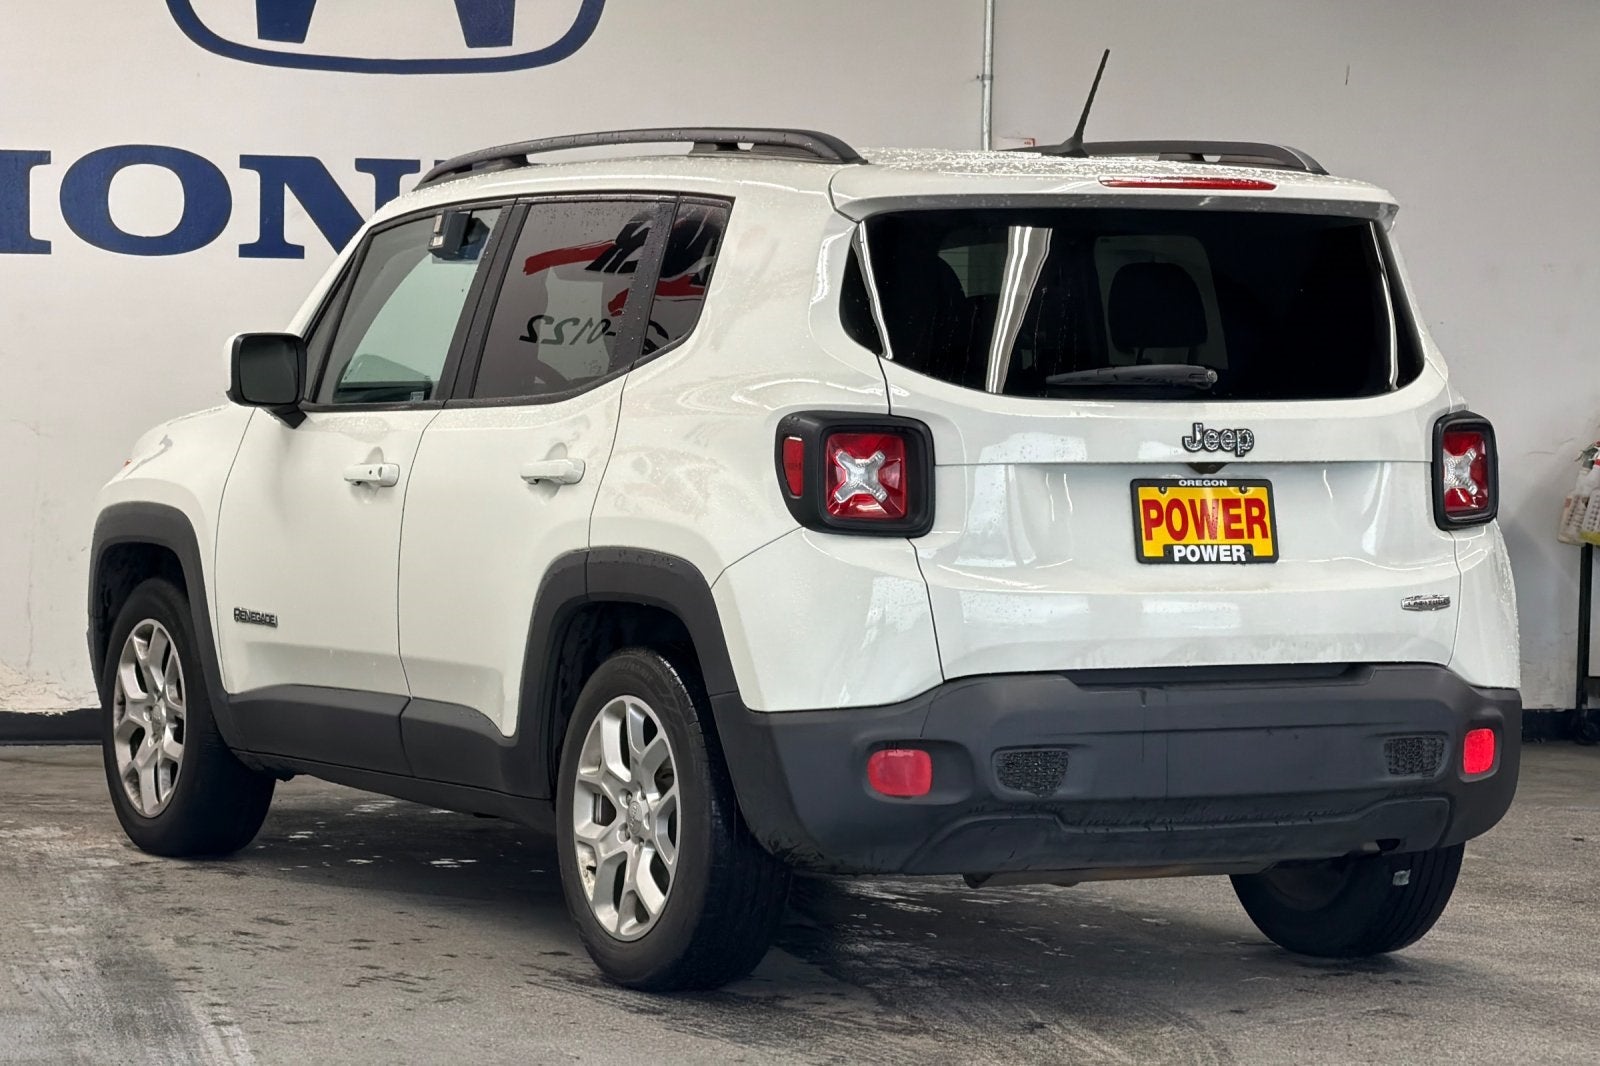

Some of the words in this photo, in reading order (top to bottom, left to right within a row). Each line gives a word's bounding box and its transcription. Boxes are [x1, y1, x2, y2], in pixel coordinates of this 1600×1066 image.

[1182, 422, 1255, 457] Jeep
[1178, 479, 1228, 487] OREGON
[1142, 498, 1269, 541] POWER
[1173, 544, 1246, 562] POWER
[234, 608, 277, 627] RENEGADE
